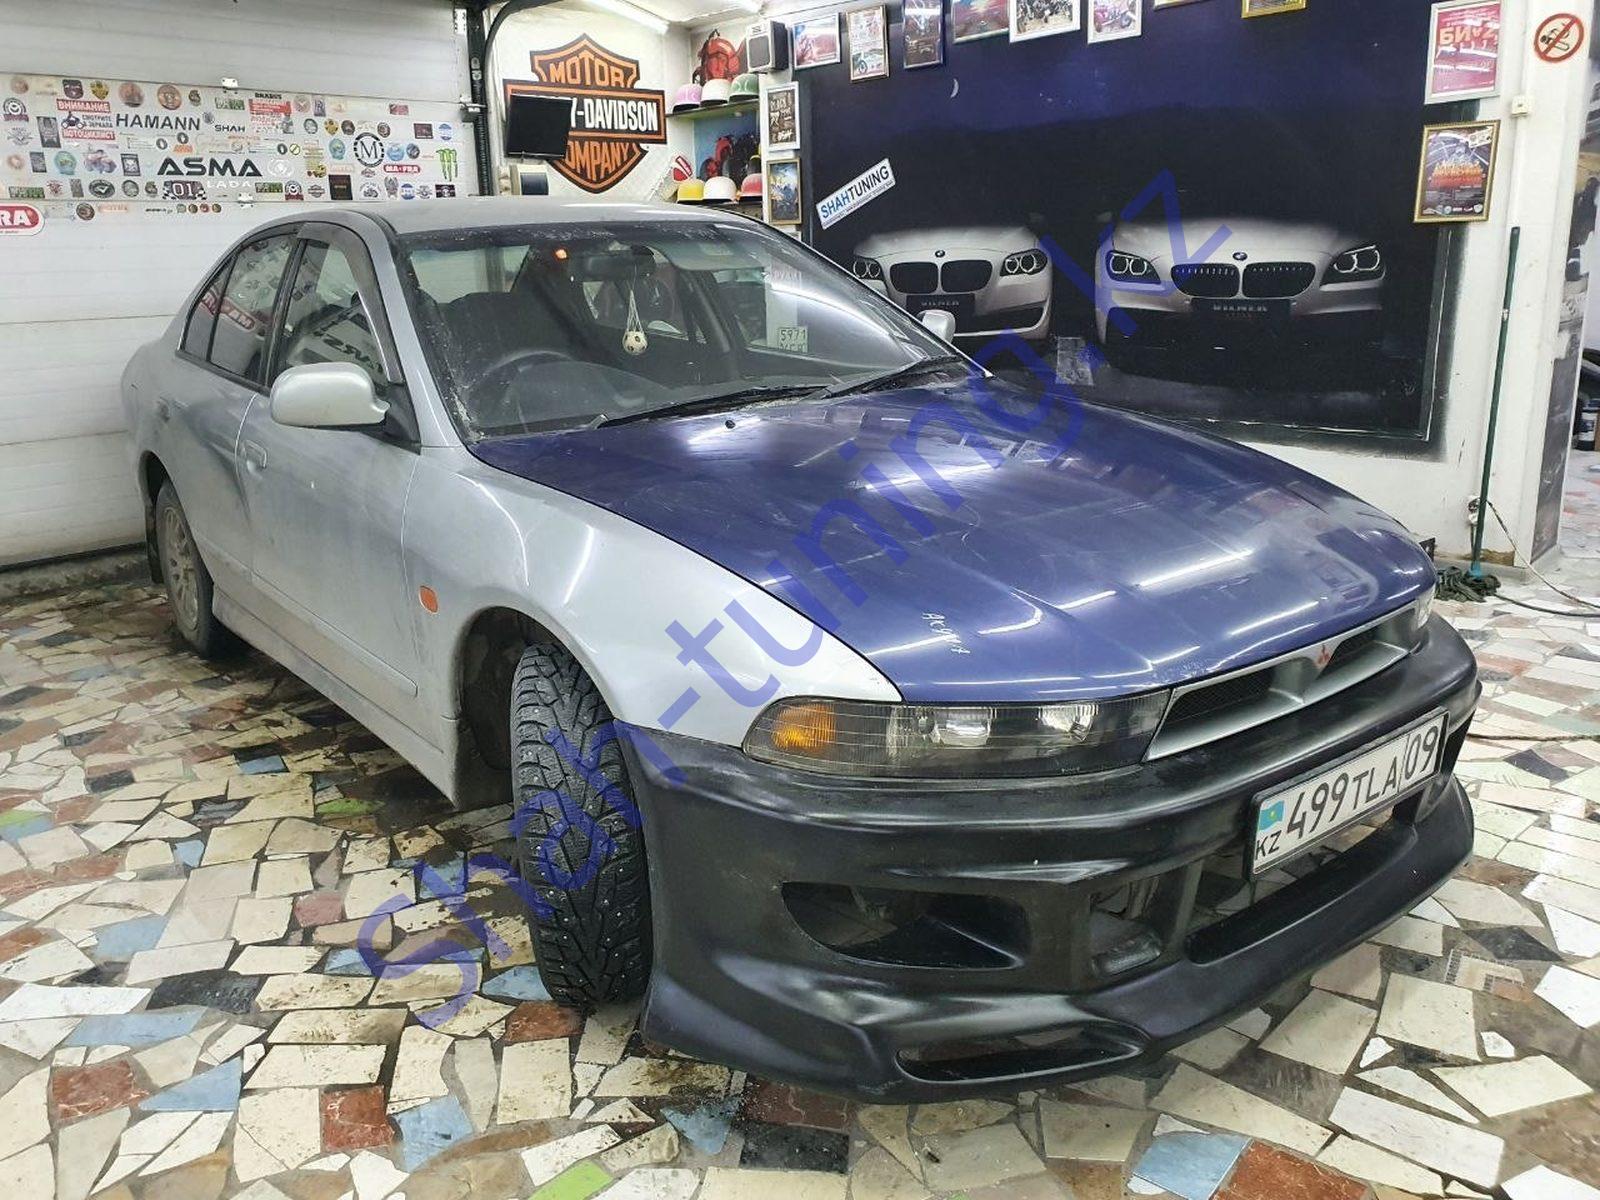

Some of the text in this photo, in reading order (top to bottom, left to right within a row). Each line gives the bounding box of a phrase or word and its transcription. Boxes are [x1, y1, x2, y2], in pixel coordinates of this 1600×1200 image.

[549, 50, 625, 88] MOTOR
[115, 113, 200, 131] HAMANN
[214, 124, 246, 133] SHAH
[157, 157, 263, 177] ASMA
[820, 165, 890, 219] SHAHTUNING
[1254, 829, 1283, 861] KZ
